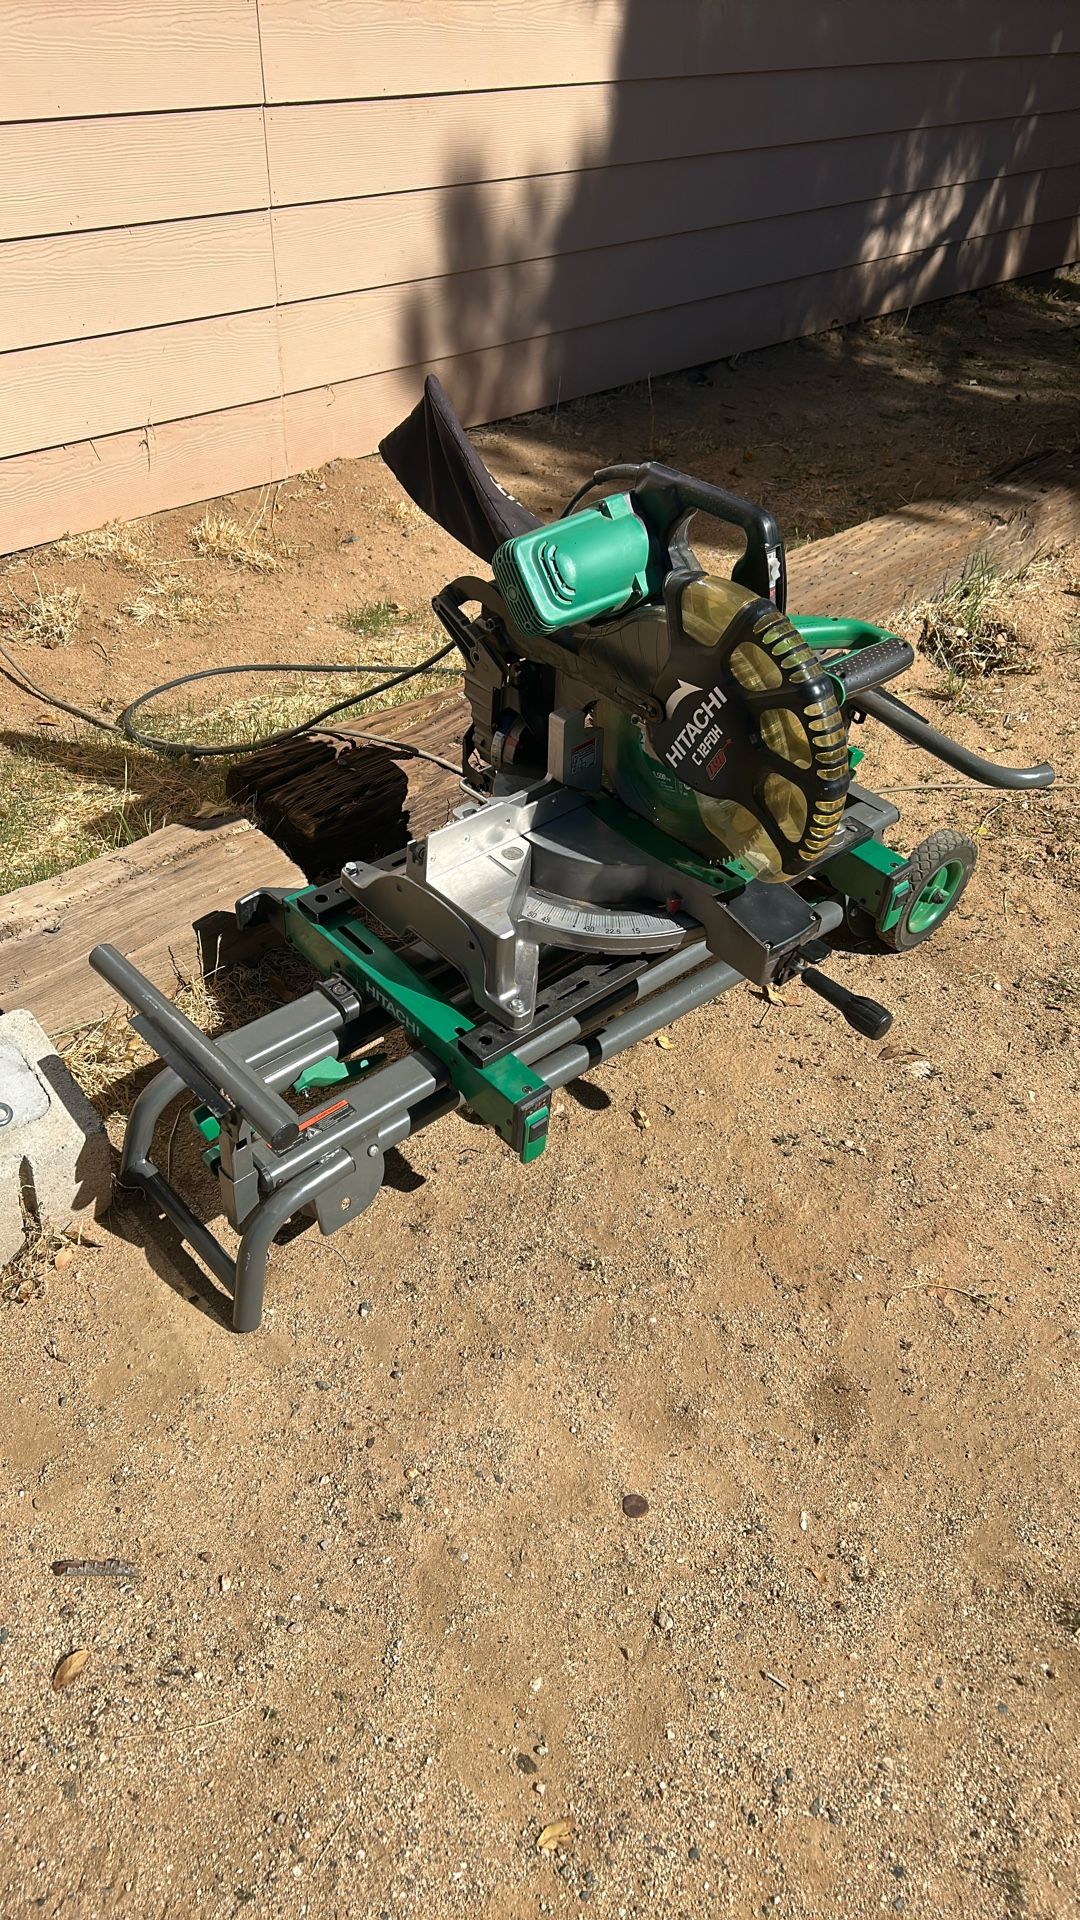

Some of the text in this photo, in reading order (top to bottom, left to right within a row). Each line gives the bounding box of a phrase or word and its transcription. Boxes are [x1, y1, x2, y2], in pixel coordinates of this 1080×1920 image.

[665, 686, 727, 768] HITACHI
[692, 753, 702, 766] C
[697, 724, 723, 759] 12FDH
[527, 911, 537, 919] 50
[541, 916, 551, 924] 45
[585, 925, 595, 933] 30
[366, 981, 420, 1037] HITACHI
